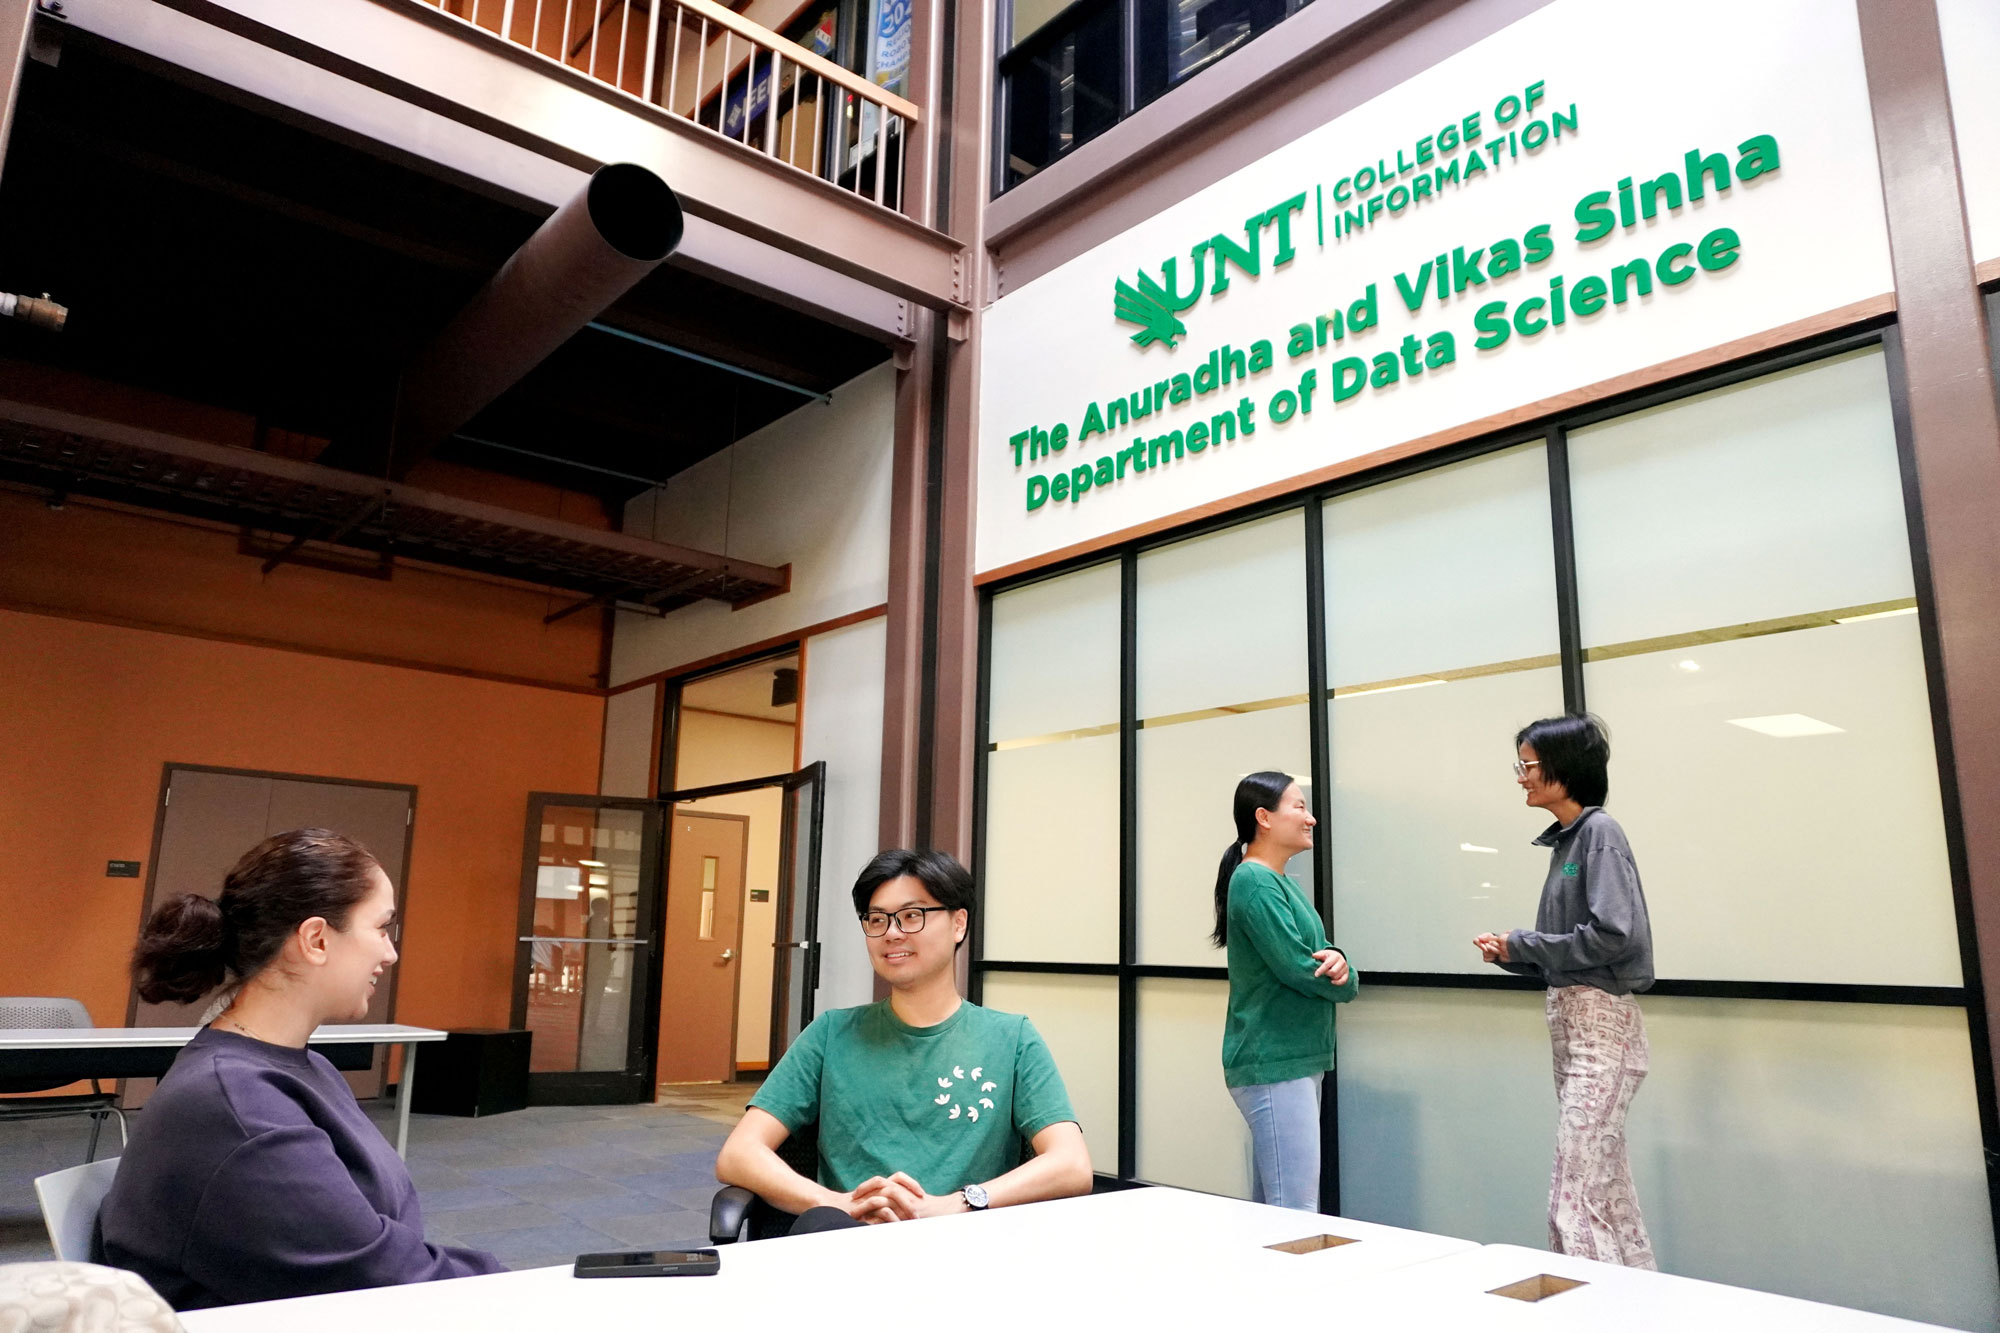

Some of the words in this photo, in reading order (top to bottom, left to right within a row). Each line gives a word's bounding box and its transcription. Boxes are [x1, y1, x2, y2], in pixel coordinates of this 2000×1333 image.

[881, 37, 912, 58] ROBO
[1333, 111, 1483, 203] COLLEGE
[1493, 79, 1545, 124] OF
[1334, 103, 1579, 239] INFORMATION
[1008, 422, 1070, 467] The
[1078, 339, 1274, 441] Anuradha
[1286, 282, 1379, 358] and
[1393, 223, 1555, 311] Vikas
[1573, 133, 1781, 243] Sinha
[1161, 191, 1307, 312] UNT
[1026, 396, 1256, 512] Department
[1268, 368, 1318, 423] of
[1331, 330, 1457, 403] Data
[1473, 227, 1741, 350] Science
